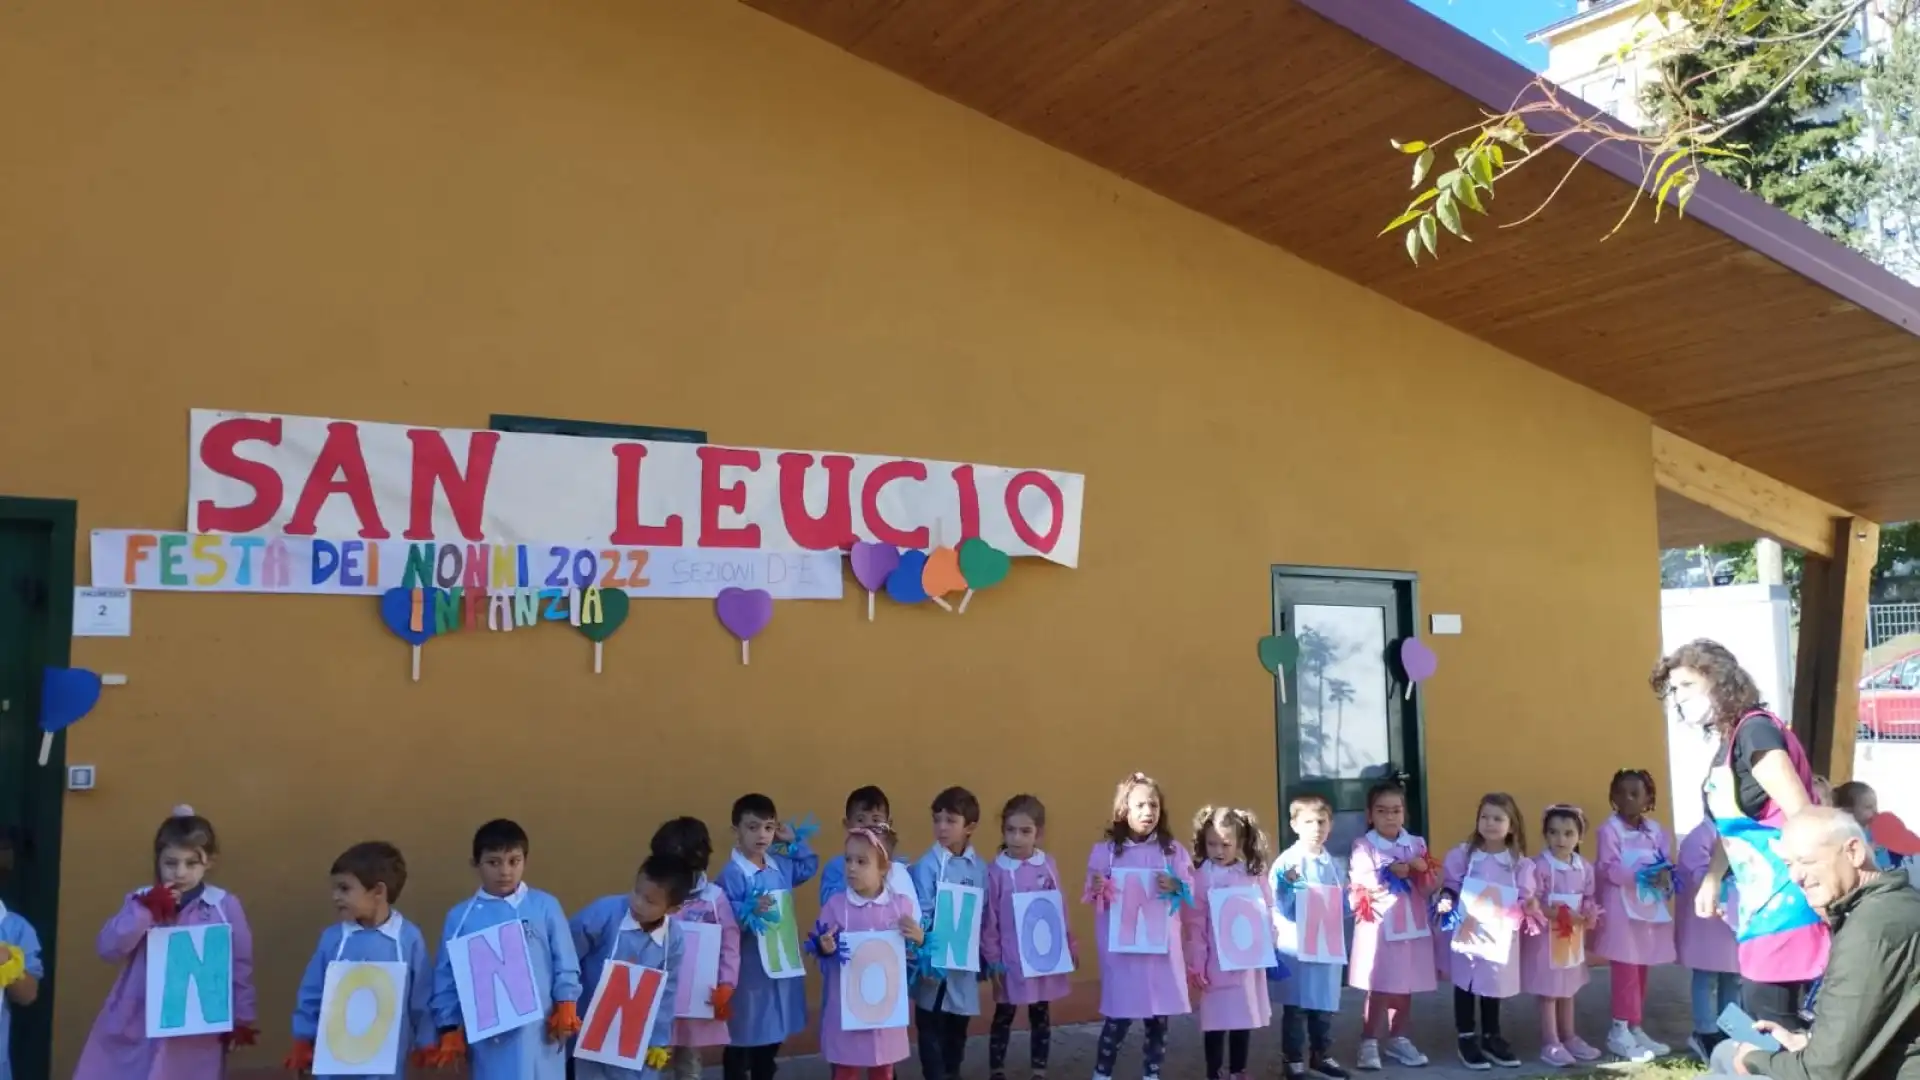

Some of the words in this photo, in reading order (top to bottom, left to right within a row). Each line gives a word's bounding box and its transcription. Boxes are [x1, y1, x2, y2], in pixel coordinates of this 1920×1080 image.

[197, 417, 501, 542] SAN
[610, 443, 1064, 554] LEUCIO
[124, 534, 291, 587] FESTA
[311, 539, 379, 587] DEI
[401, 542, 530, 588] NONNI
[544, 546, 650, 588] 2022
[668, 559, 755, 584] SEZIONI
[766, 553, 815, 584] D-E
[98, 604, 107, 616] 2
[409, 585, 604, 635] INFANZIA
[764, 889, 802, 972] N
[935, 892, 976, 967] N
[1022, 896, 1063, 974] O
[1120, 870, 1157, 946] N
[1217, 895, 1264, 966] O
[1303, 885, 1346, 959] N
[160, 929, 231, 1029] N
[325, 965, 396, 1064] O
[466, 922, 537, 1032] N
[581, 966, 661, 1058] N
[849, 938, 904, 1025] O
